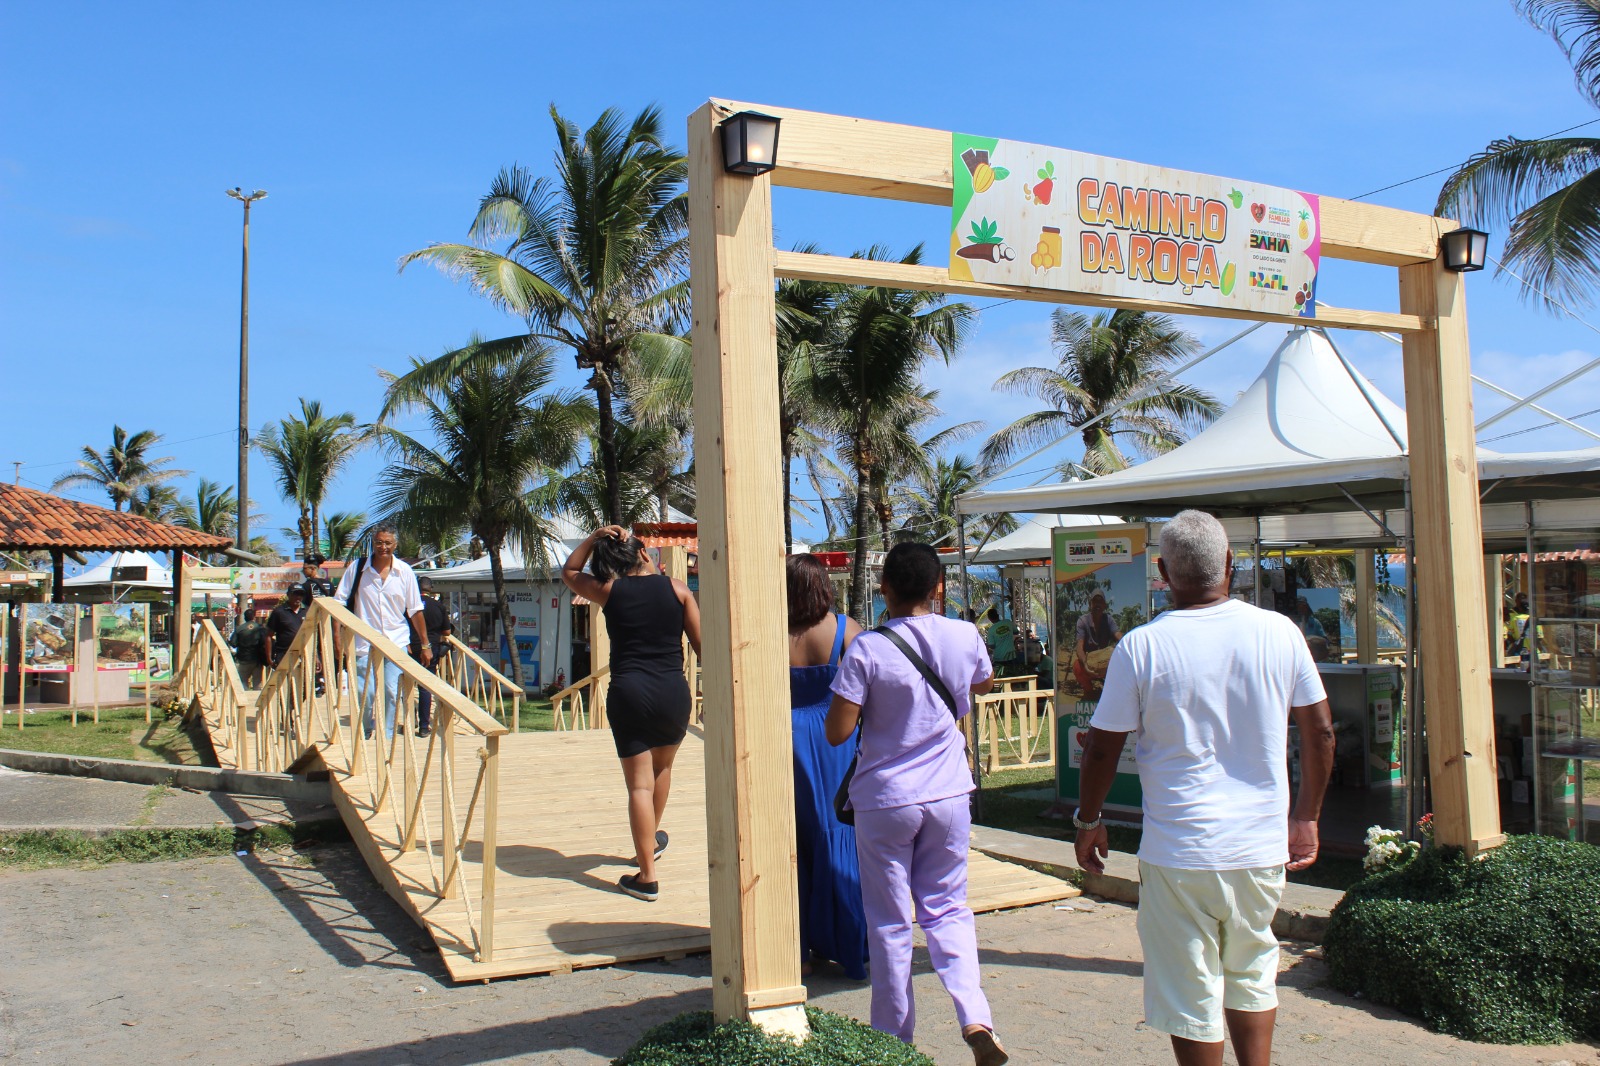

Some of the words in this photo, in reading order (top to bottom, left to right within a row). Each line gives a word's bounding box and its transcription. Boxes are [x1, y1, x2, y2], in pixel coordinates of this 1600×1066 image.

[1077, 177, 1228, 243] CAMINHO
[1269, 214, 1290, 223] FAMILIAR
[1250, 234, 1289, 253] BAHIA
[1080, 231, 1125, 274] DA
[1128, 233, 1221, 295] ROÇA
[1249, 271, 1288, 290] BRASIL
[1070, 546, 1095, 555] BAHIA
[1101, 545, 1127, 554] BRASIL
[260, 572, 300, 581] CAMINHO
[261, 581, 272, 590] DA
